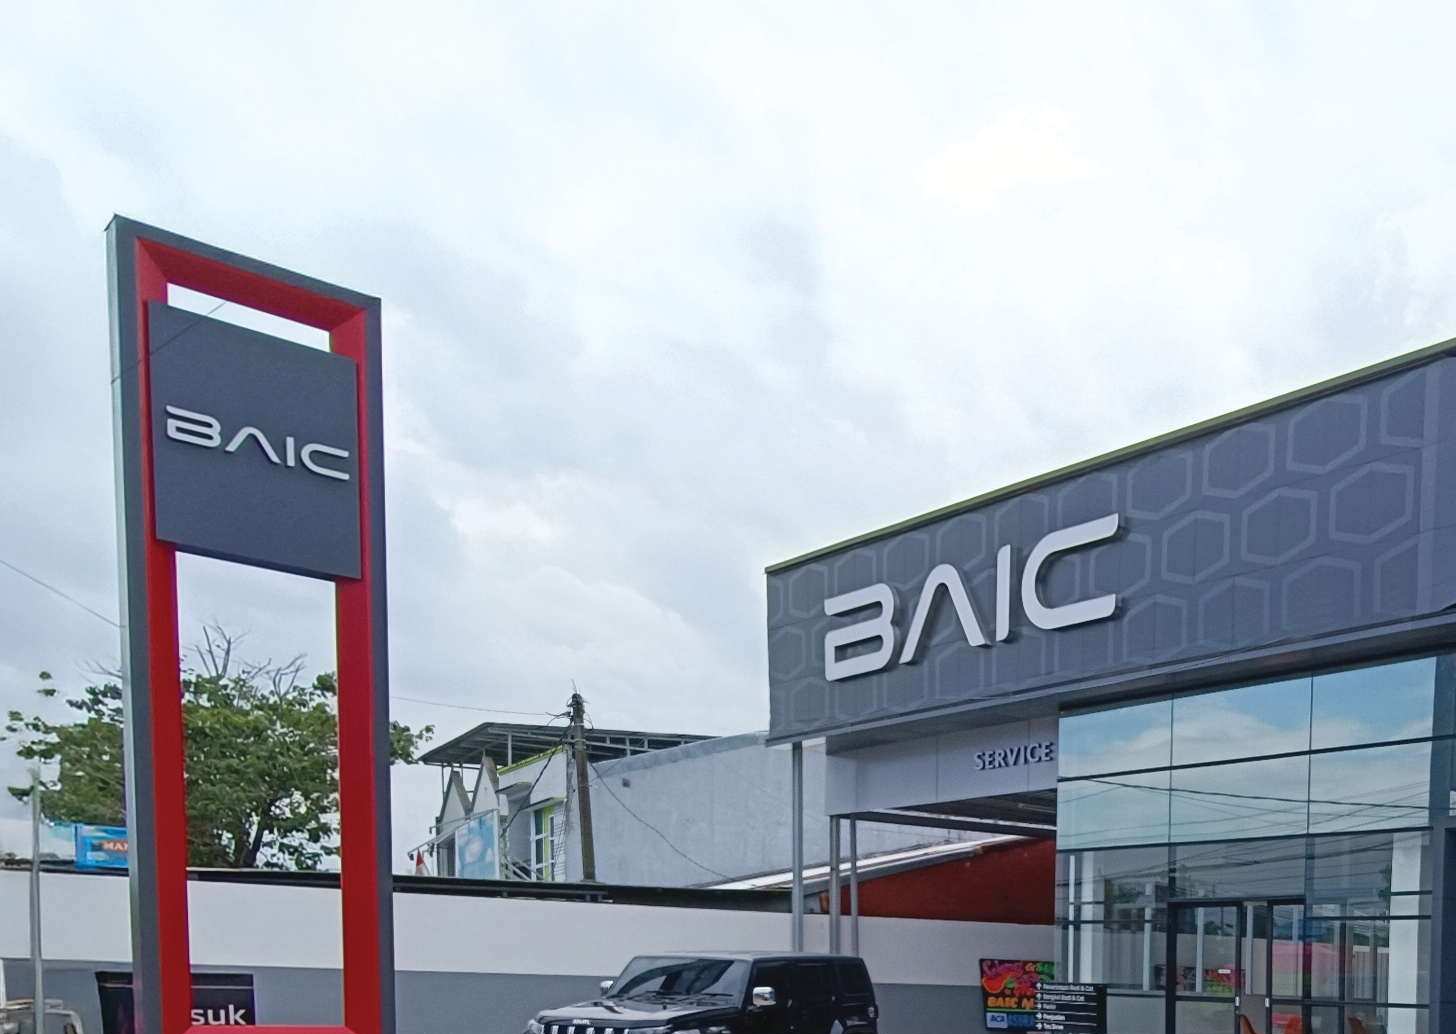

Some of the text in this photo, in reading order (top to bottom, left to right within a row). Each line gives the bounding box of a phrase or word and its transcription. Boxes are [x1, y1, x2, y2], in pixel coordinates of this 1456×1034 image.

[165, 404, 350, 481] BAIC
[823, 513, 1119, 682] BAIC
[974, 742, 1054, 770] SERVICE
[191, 1004, 247, 1025] suk
